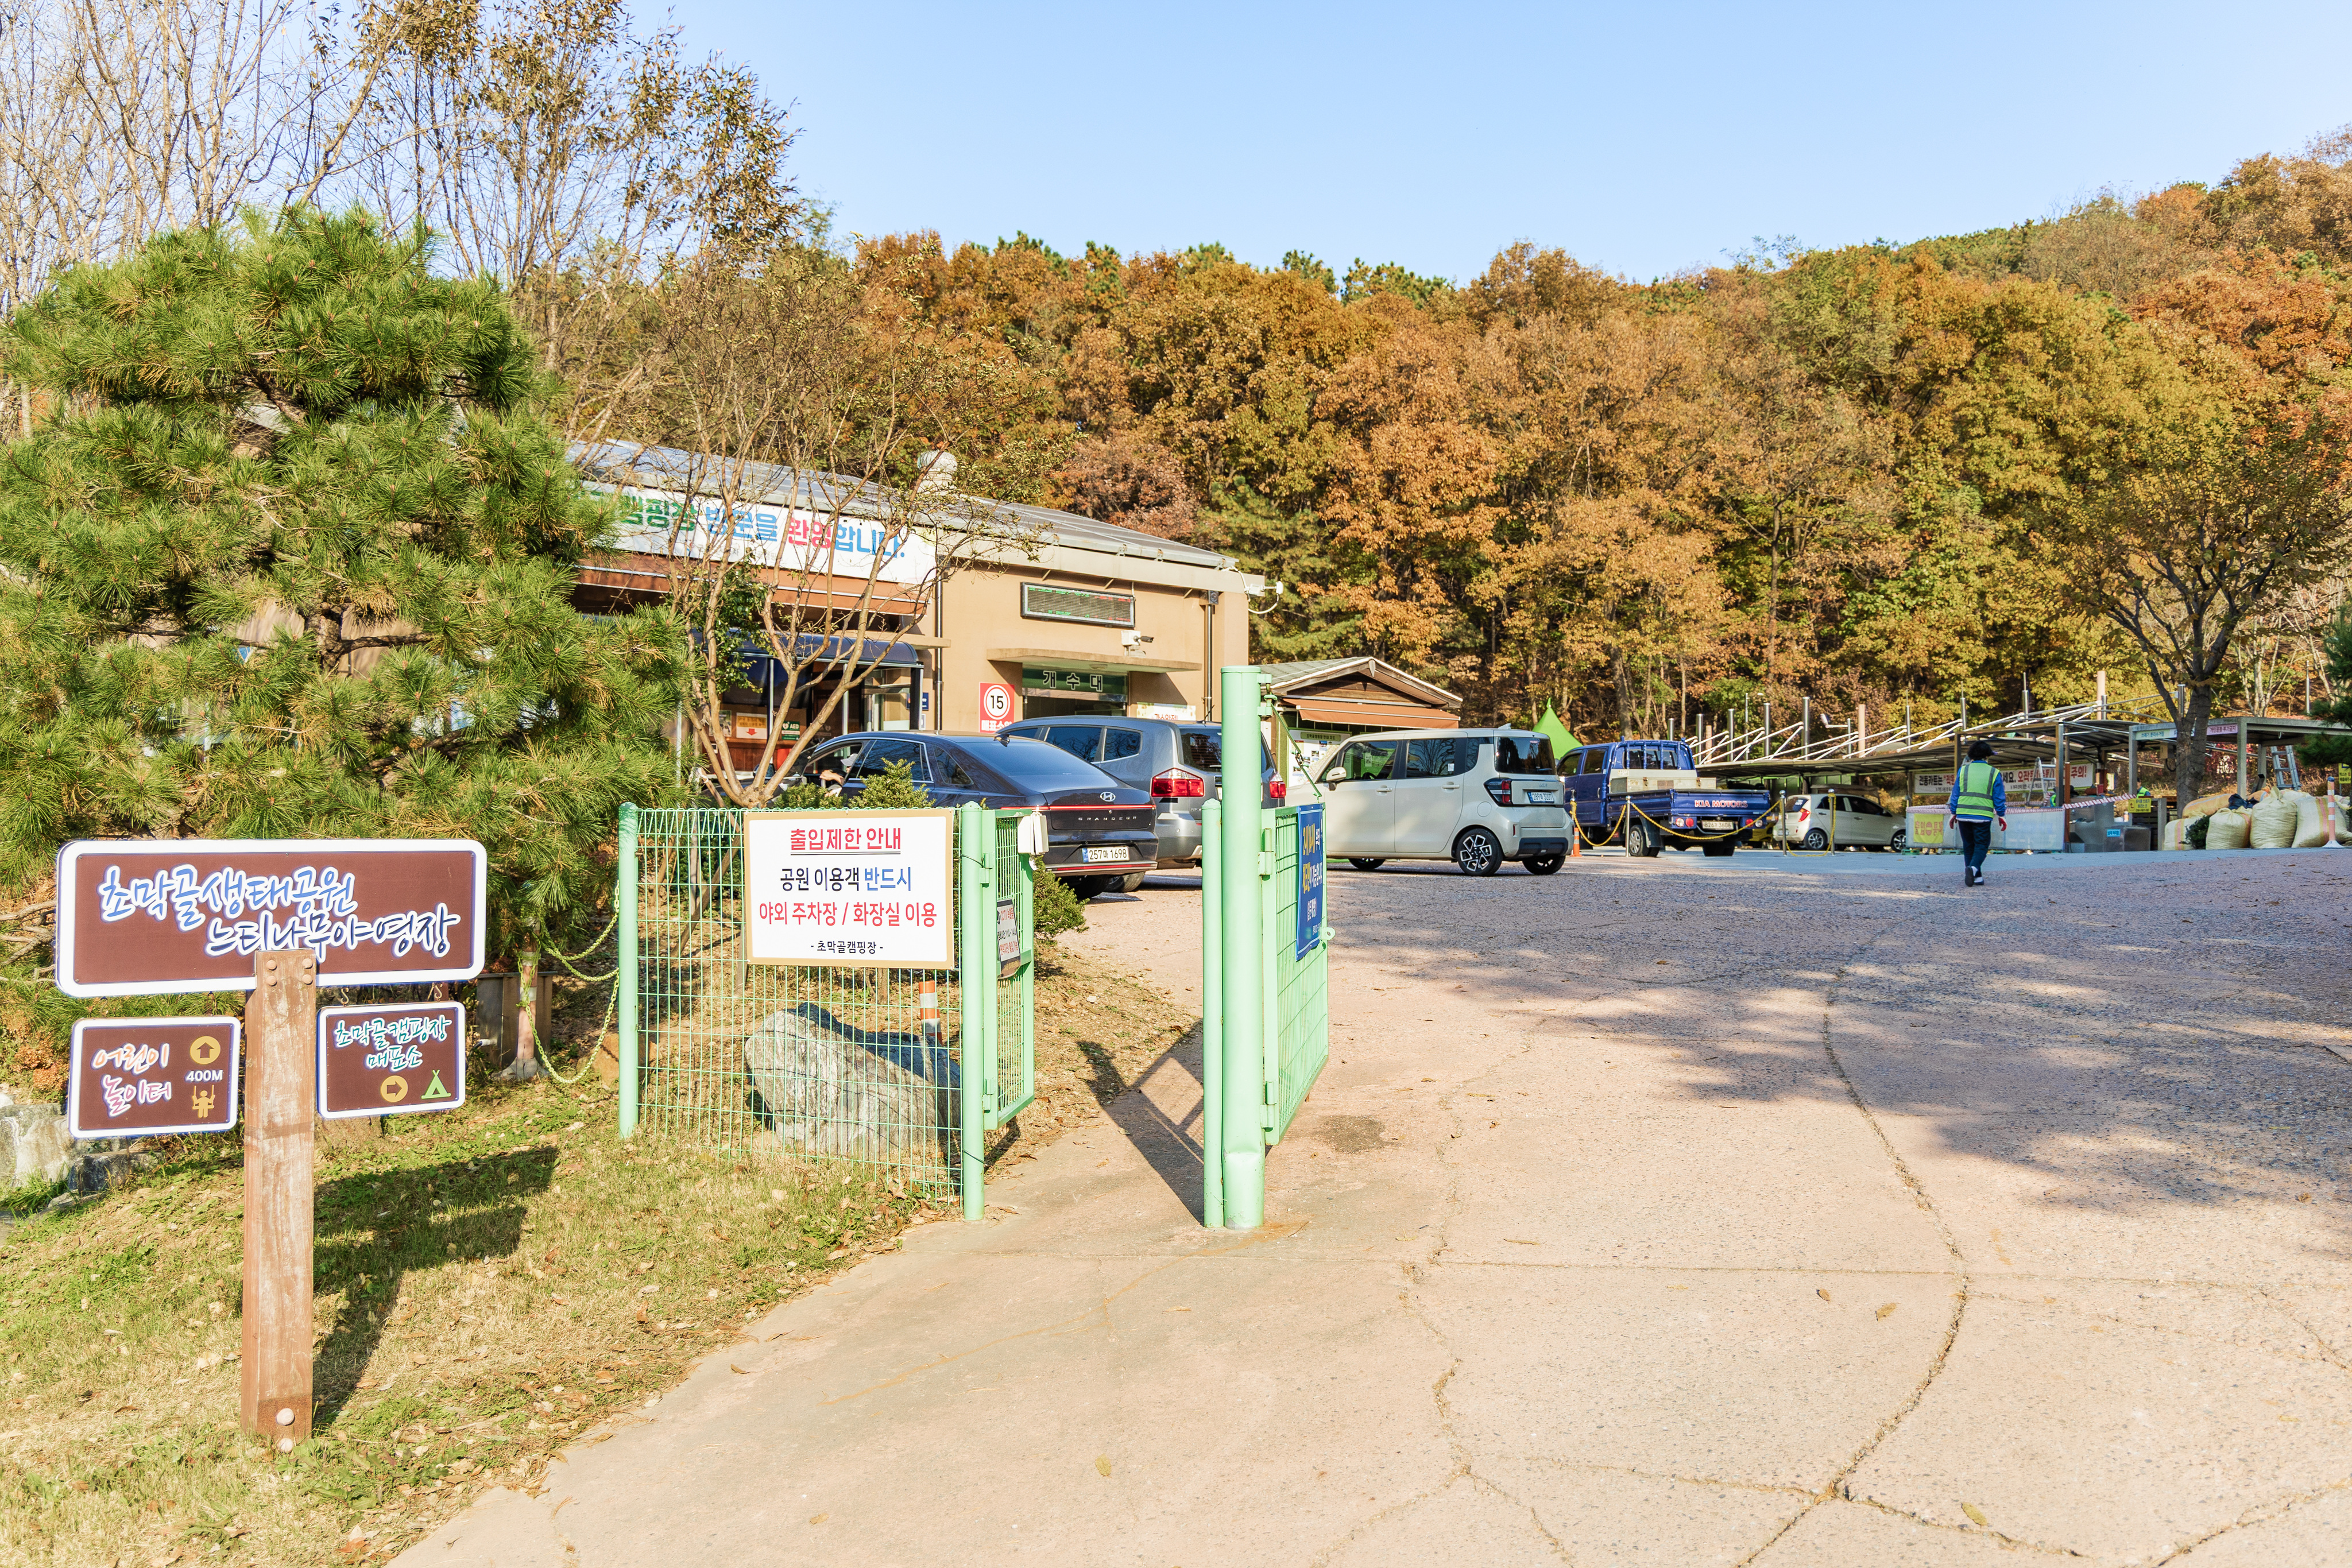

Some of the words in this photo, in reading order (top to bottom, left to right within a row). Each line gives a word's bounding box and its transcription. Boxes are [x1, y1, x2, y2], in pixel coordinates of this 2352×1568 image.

[706, 506, 777, 541] 방문을
[788, 517, 905, 558] 환영합니다.
[990, 695, 1004, 709] 15
[2071, 766, 2087, 778] 주의!
[1712, 800, 1748, 808] MOTORS
[790, 828, 862, 850] 출입제한
[866, 828, 901, 850] 안내
[1110, 849, 1127, 859] 1698
[780, 867, 809, 891] 공원
[814, 867, 860, 891] 이용객
[864, 866, 911, 891] 반드시
[100, 865, 357, 930] 초막골생태공원
[759, 901, 788, 925] 야외
[792, 901, 838, 926] 주차장
[853, 901, 901, 927] 화장실
[905, 902, 937, 927] 이용
[207, 905, 459, 960] 느티나무야영장
[817, 940, 877, 954] 초막골캠핑장
[335, 1015, 452, 1050] 초막골캠핑장
[92, 1043, 169, 1075] 어린이
[366, 1045, 423, 1072] 매표소
[186, 1070, 223, 1082] 400M
[102, 1075, 172, 1116] 놀이터
